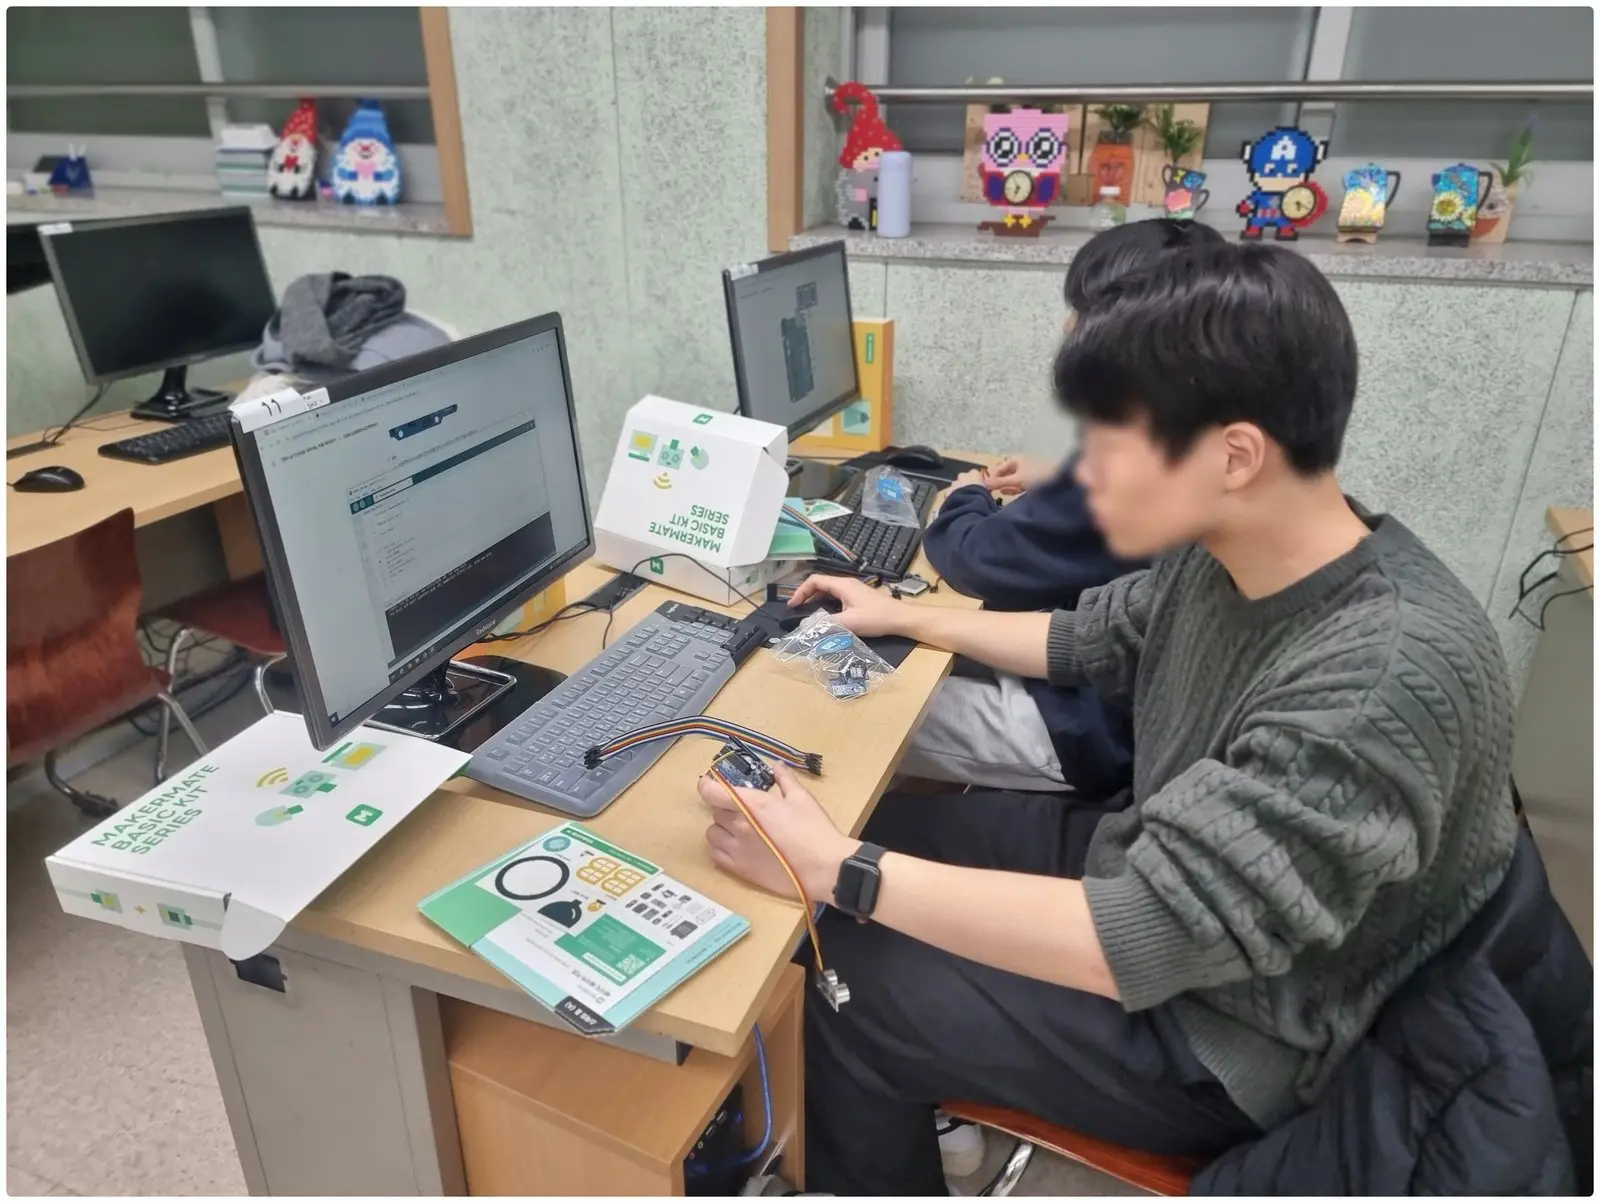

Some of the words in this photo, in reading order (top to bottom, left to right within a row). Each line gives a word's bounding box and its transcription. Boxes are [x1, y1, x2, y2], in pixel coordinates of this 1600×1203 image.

[1270, 135, 1297, 160] A
[669, 513, 689, 528] KIT
[690, 504, 730, 525] SERIES
[648, 521, 721, 553] MAKERMATE
[690, 519, 726, 539] BASIC
[90, 764, 220, 846] MAKERMATE
[110, 808, 177, 850] BASIC
[172, 785, 208, 807] KIT
[131, 808, 203, 854] SERIES
